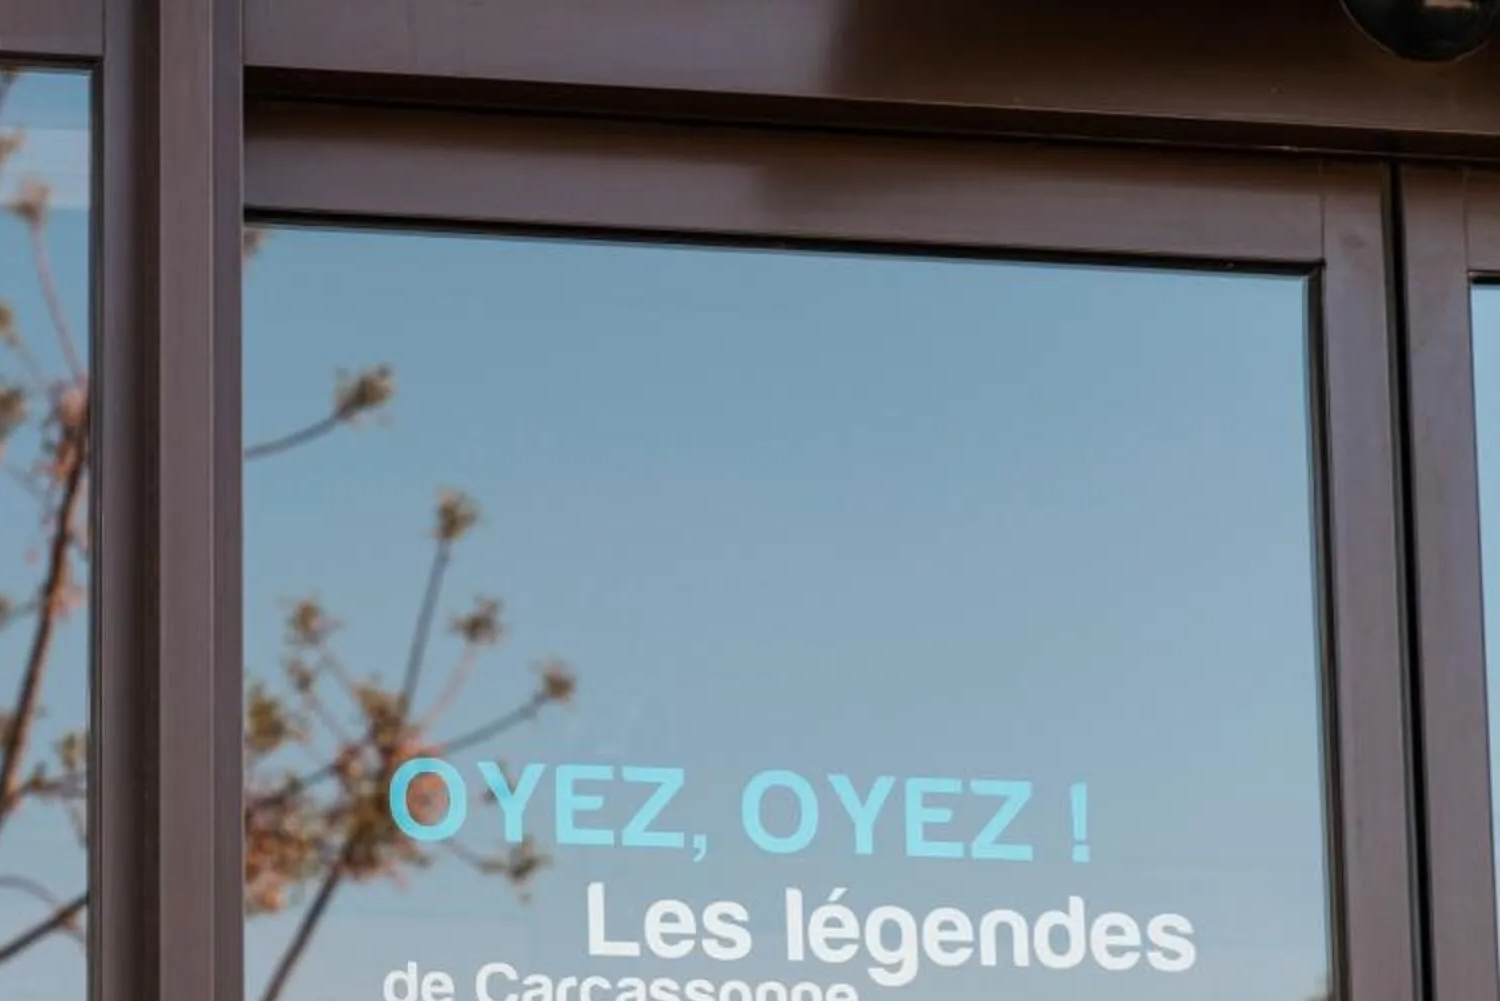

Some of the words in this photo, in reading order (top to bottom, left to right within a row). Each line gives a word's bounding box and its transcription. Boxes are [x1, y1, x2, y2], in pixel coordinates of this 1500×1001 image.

[388, 757, 708, 862] OYEZ,
[741, 769, 1034, 862] OYEZ
[1070, 782, 1091, 863] !
[586, 881, 753, 960] Les
[784, 887, 1198, 987] légendes
